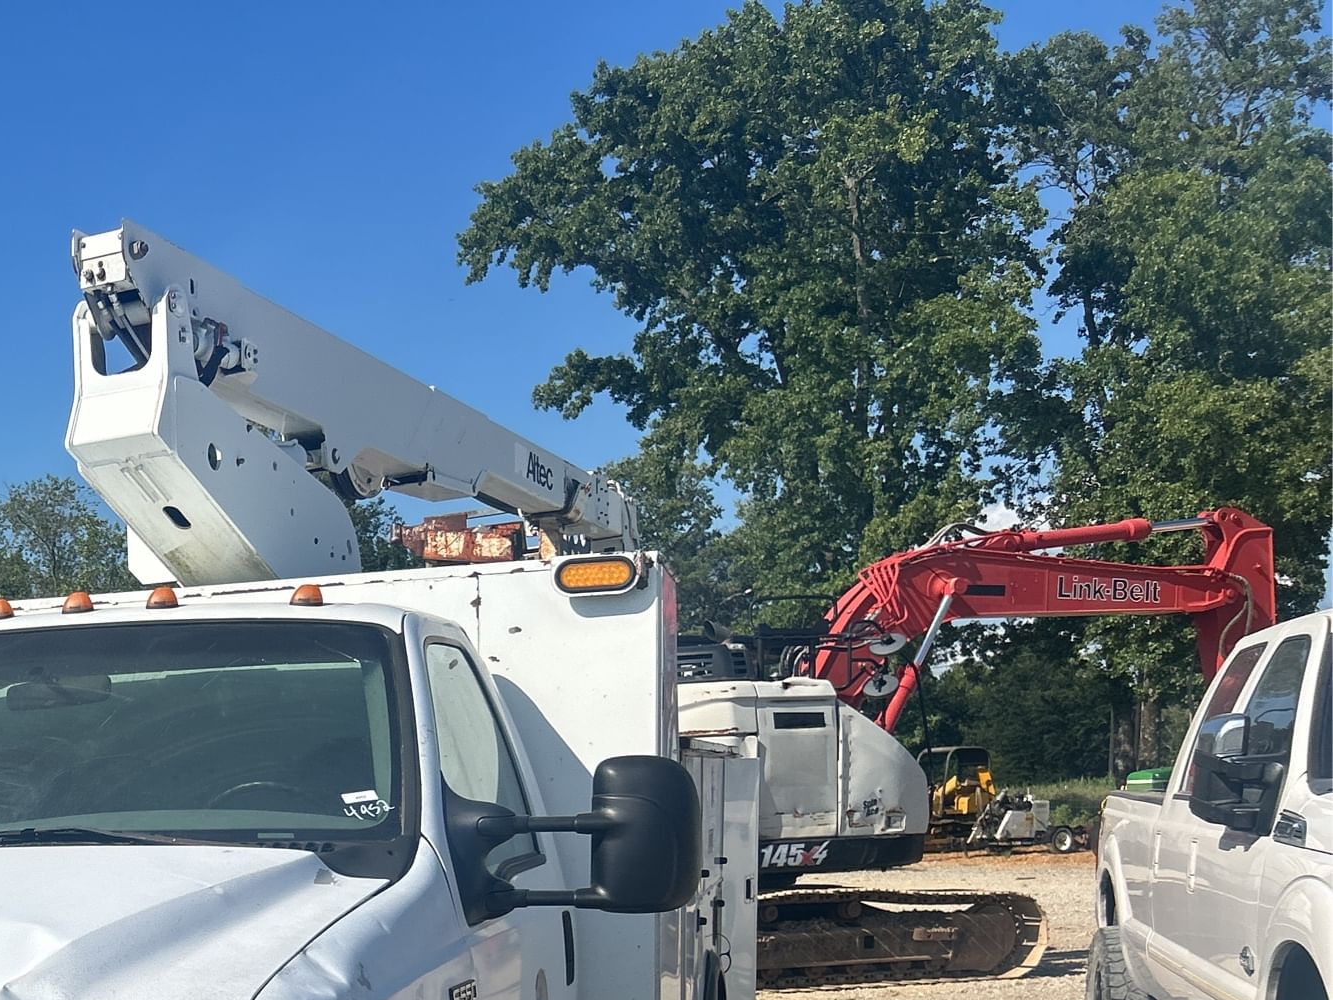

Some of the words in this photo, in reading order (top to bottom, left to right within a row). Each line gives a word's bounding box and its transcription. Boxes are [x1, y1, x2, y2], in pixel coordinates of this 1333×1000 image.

[527, 451, 553, 490] Altec
[1057, 576, 1161, 603] Link-Belt
[344, 800, 395, 820] 4952
